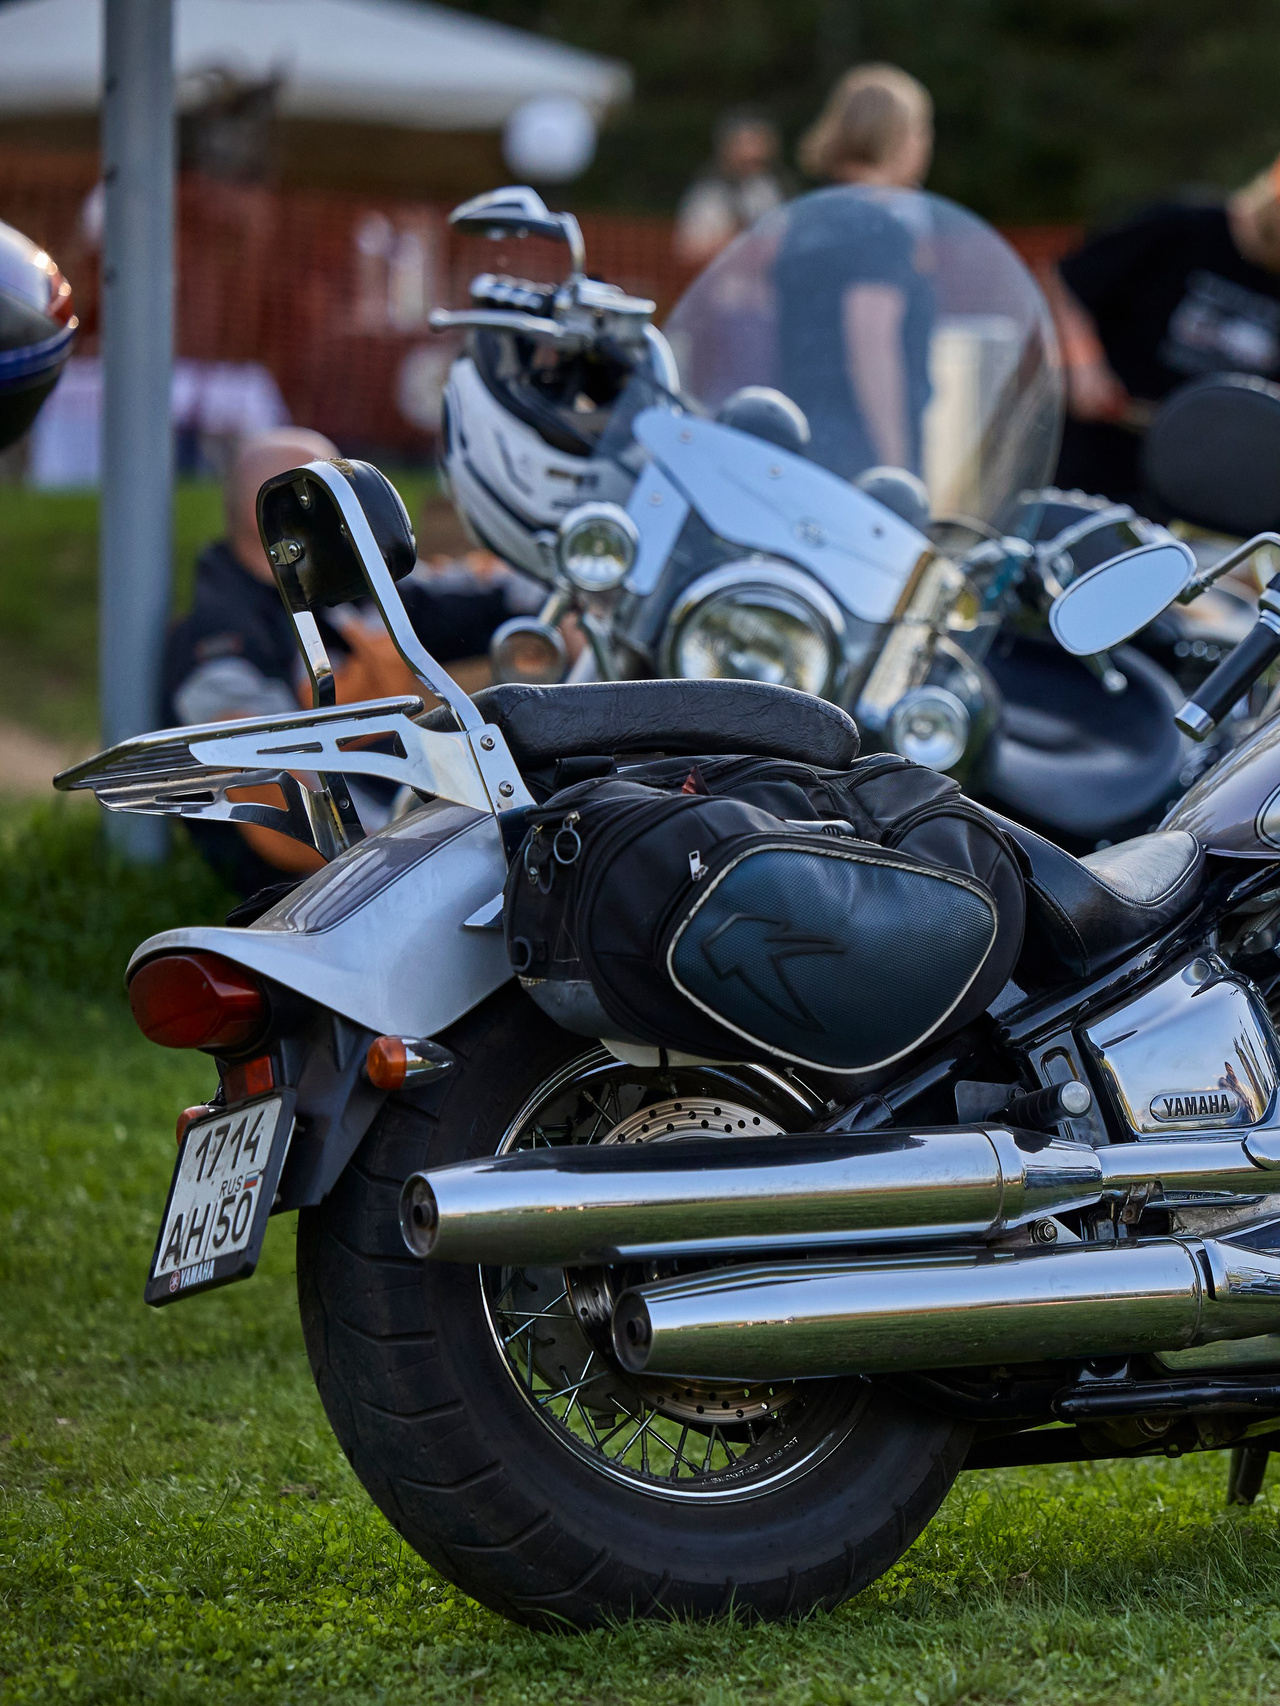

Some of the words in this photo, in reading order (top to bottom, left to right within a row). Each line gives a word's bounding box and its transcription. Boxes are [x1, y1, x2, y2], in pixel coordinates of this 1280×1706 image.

[1162, 1094, 1231, 1117] YAMAHA
[195, 1109, 265, 1183] 1714
[219, 1174, 244, 1199] RUS
[212, 1190, 254, 1249] 50
[179, 1259, 216, 1290] YAMAHA
